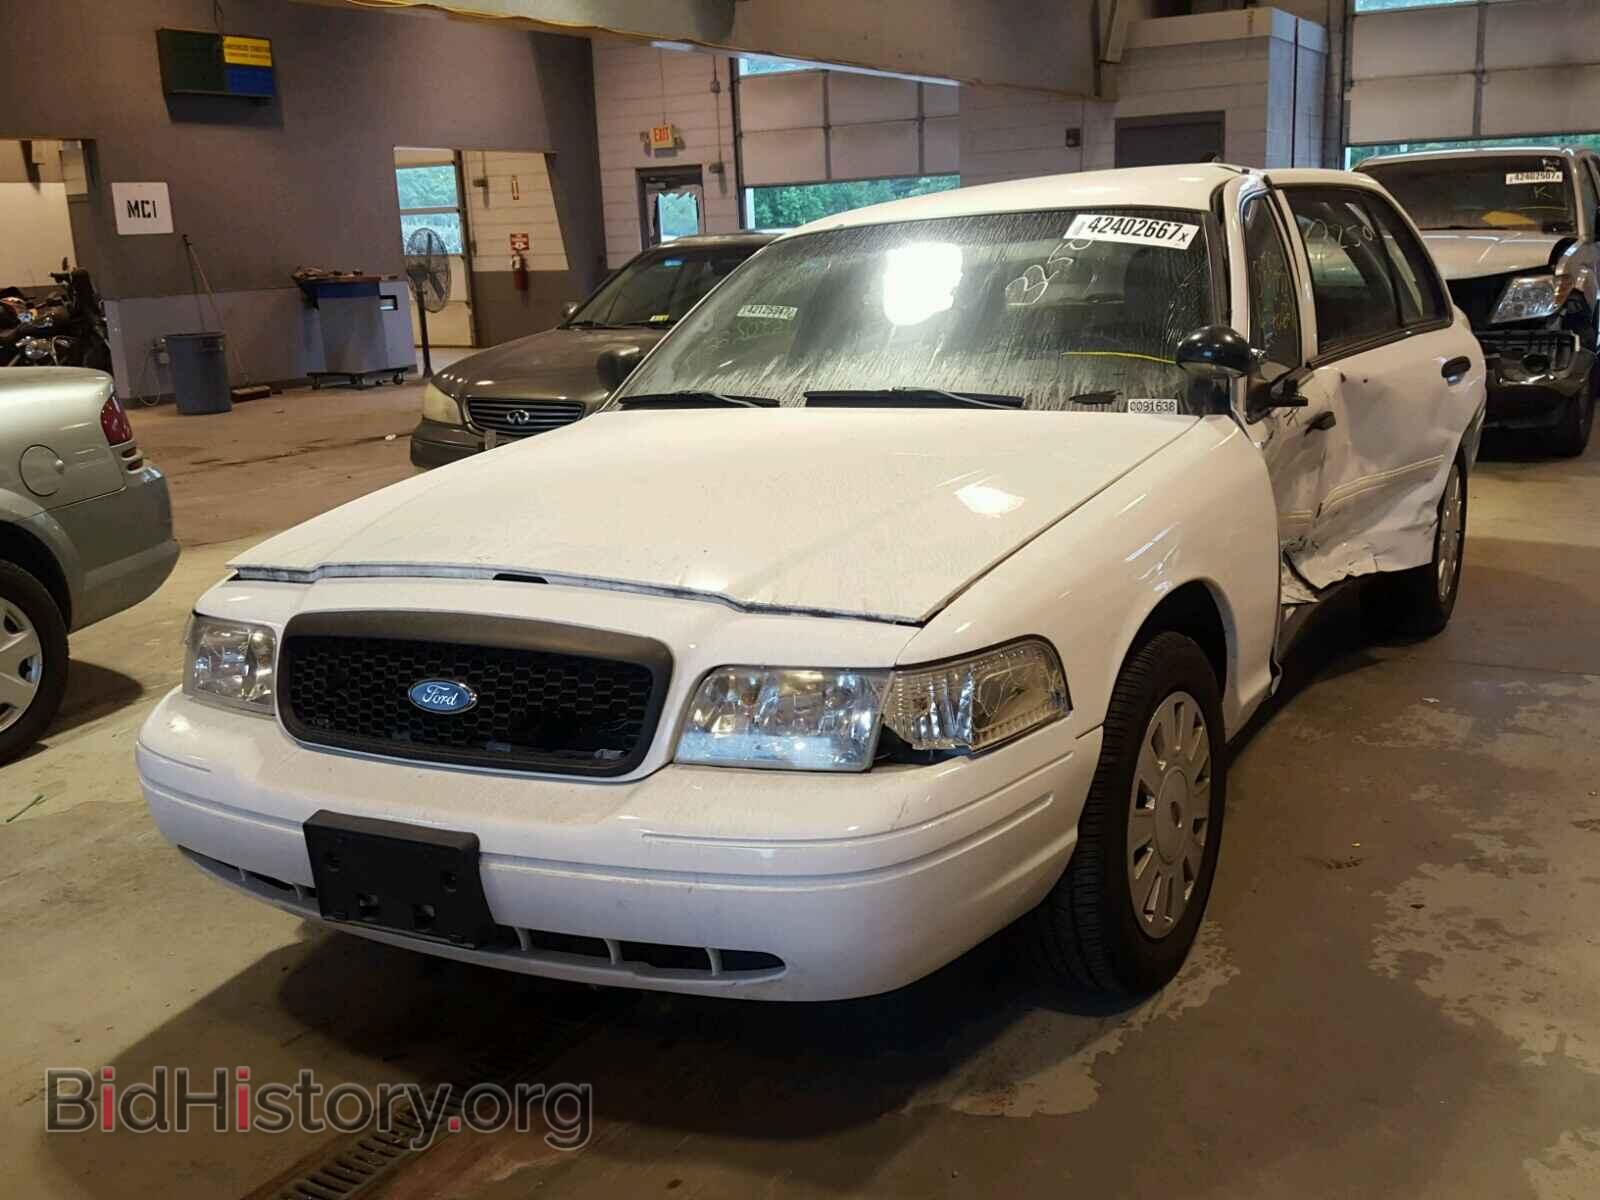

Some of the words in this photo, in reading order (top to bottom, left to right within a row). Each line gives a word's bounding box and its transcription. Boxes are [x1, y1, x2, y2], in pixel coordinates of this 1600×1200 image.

[654, 128, 669, 142] EXIT
[127, 200, 157, 218] MCI
[422, 685, 458, 706] Ford
